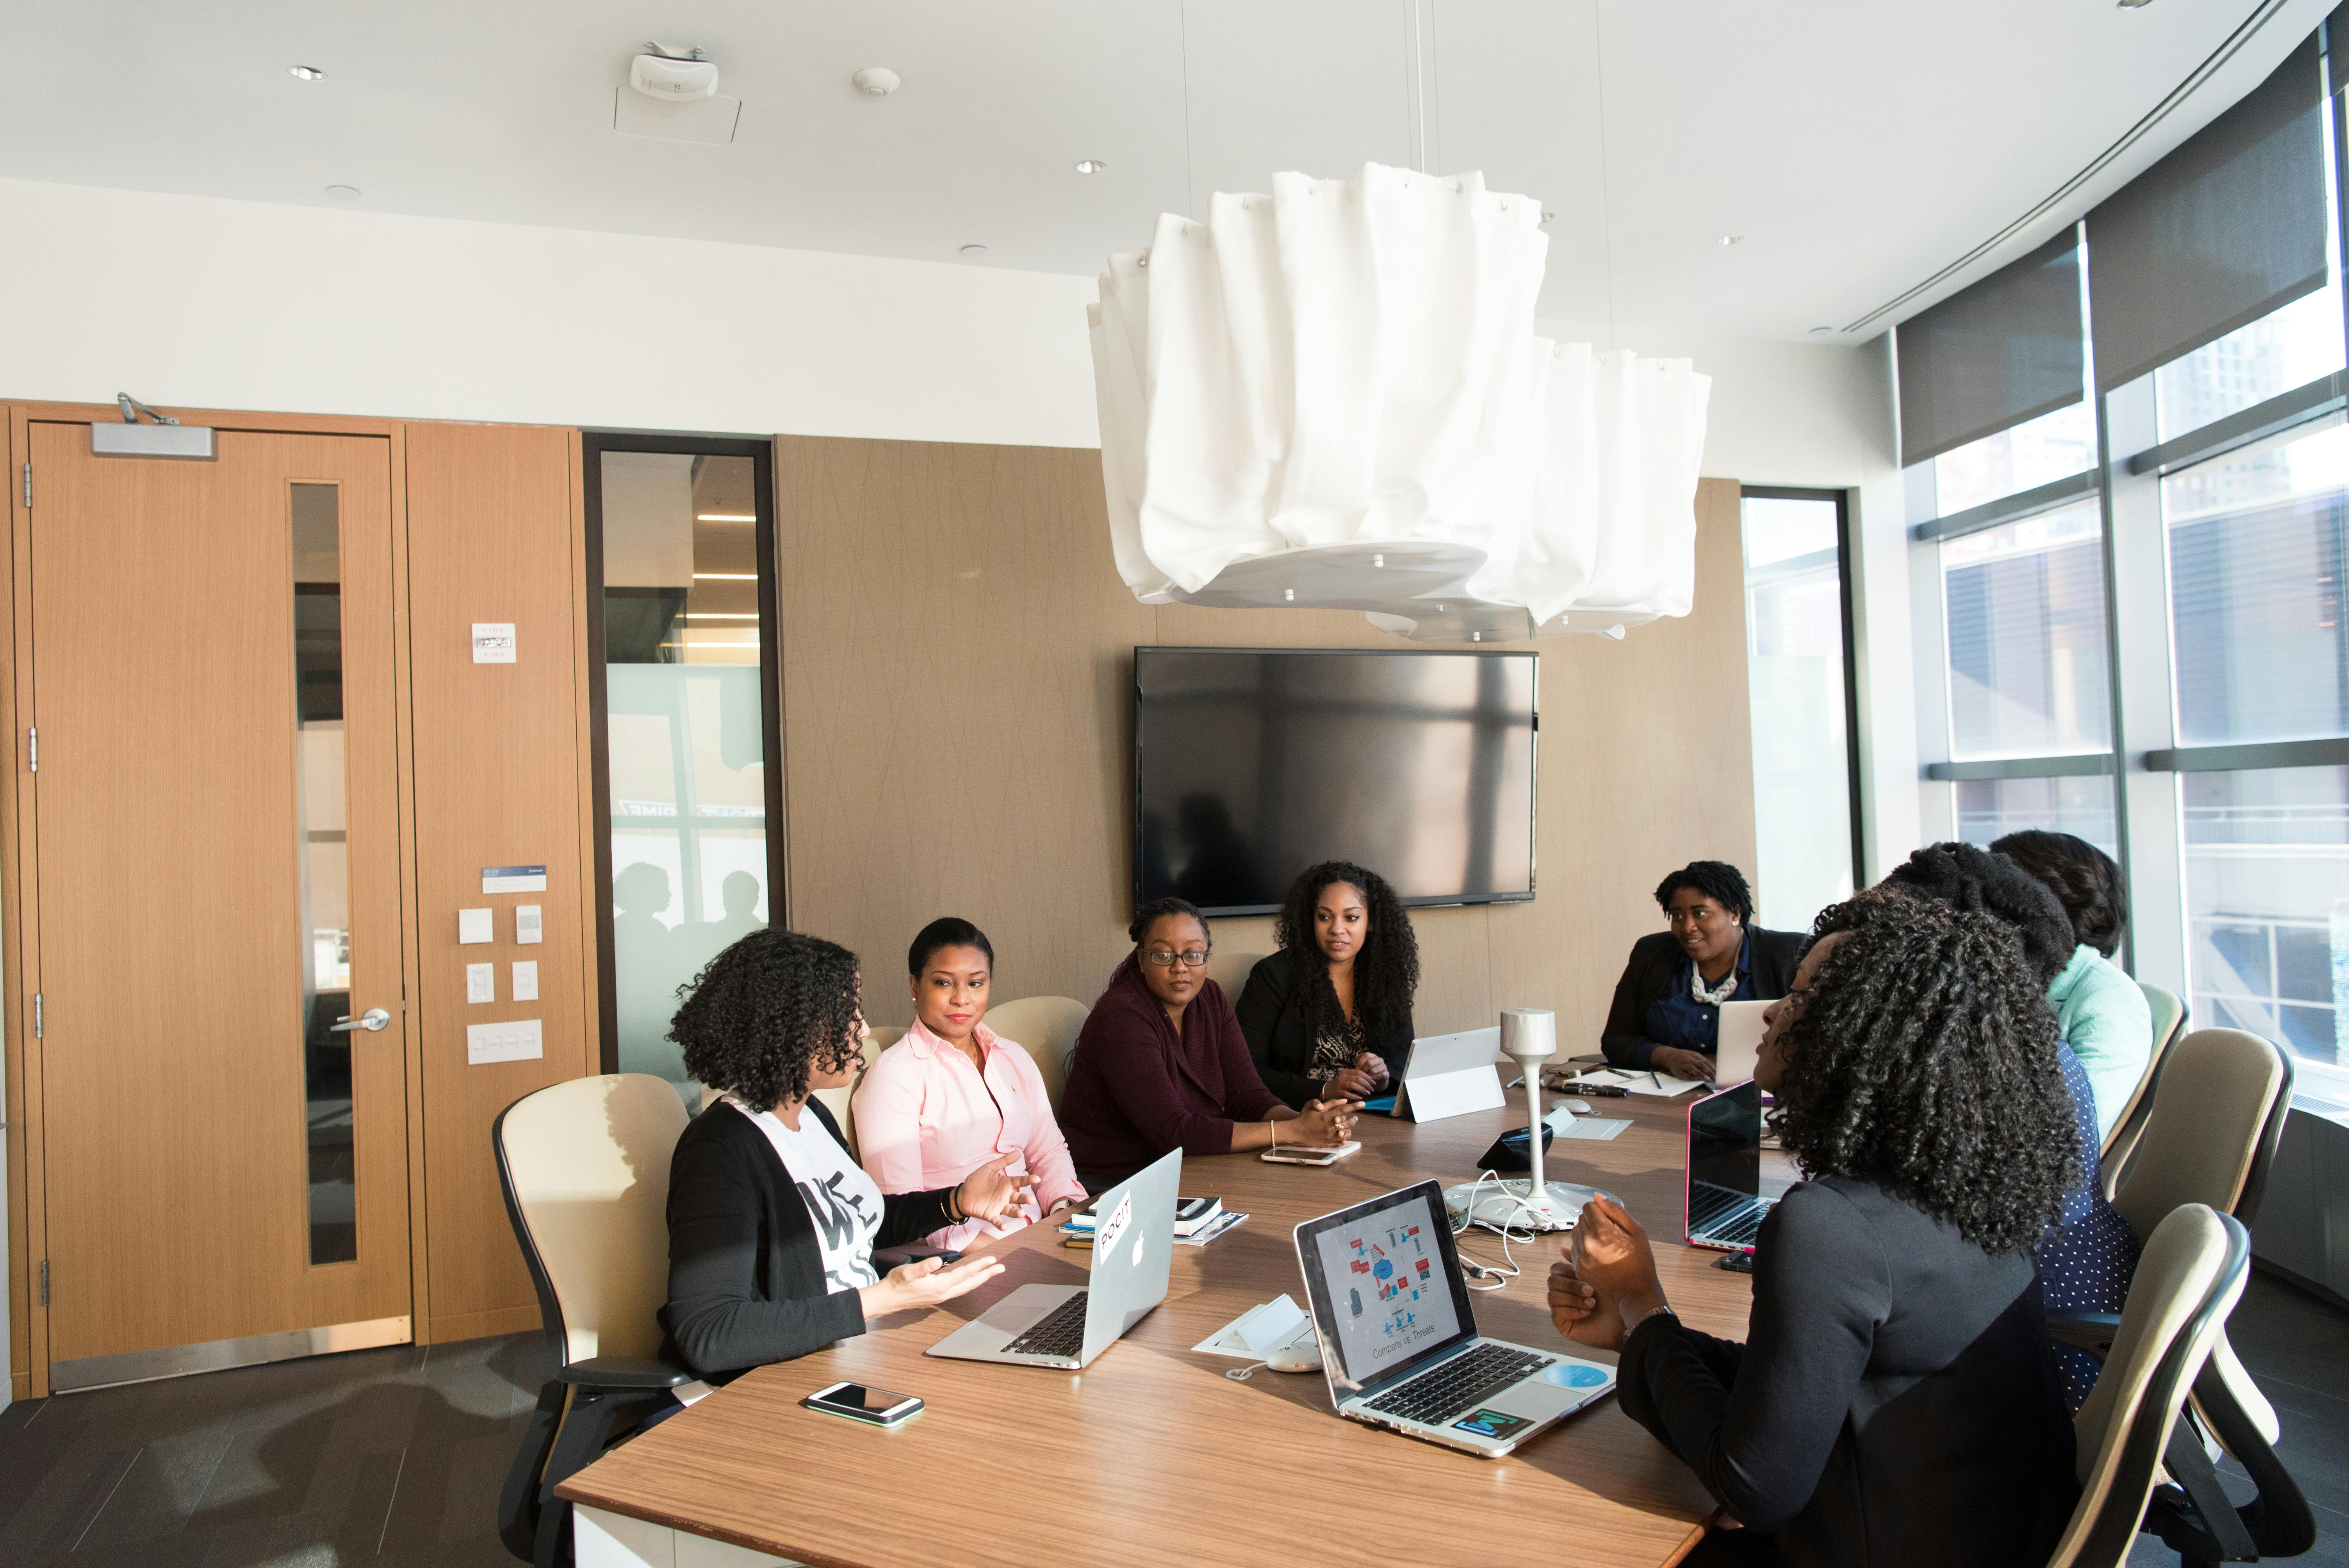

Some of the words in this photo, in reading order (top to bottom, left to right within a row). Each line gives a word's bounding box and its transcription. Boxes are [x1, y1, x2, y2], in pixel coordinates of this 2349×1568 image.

[1101, 1198, 1129, 1250] POCIT
[1372, 1340, 1402, 1359] Company
[1403, 1336, 1412, 1345] vs.
[1413, 1325, 1435, 1340] Threats
